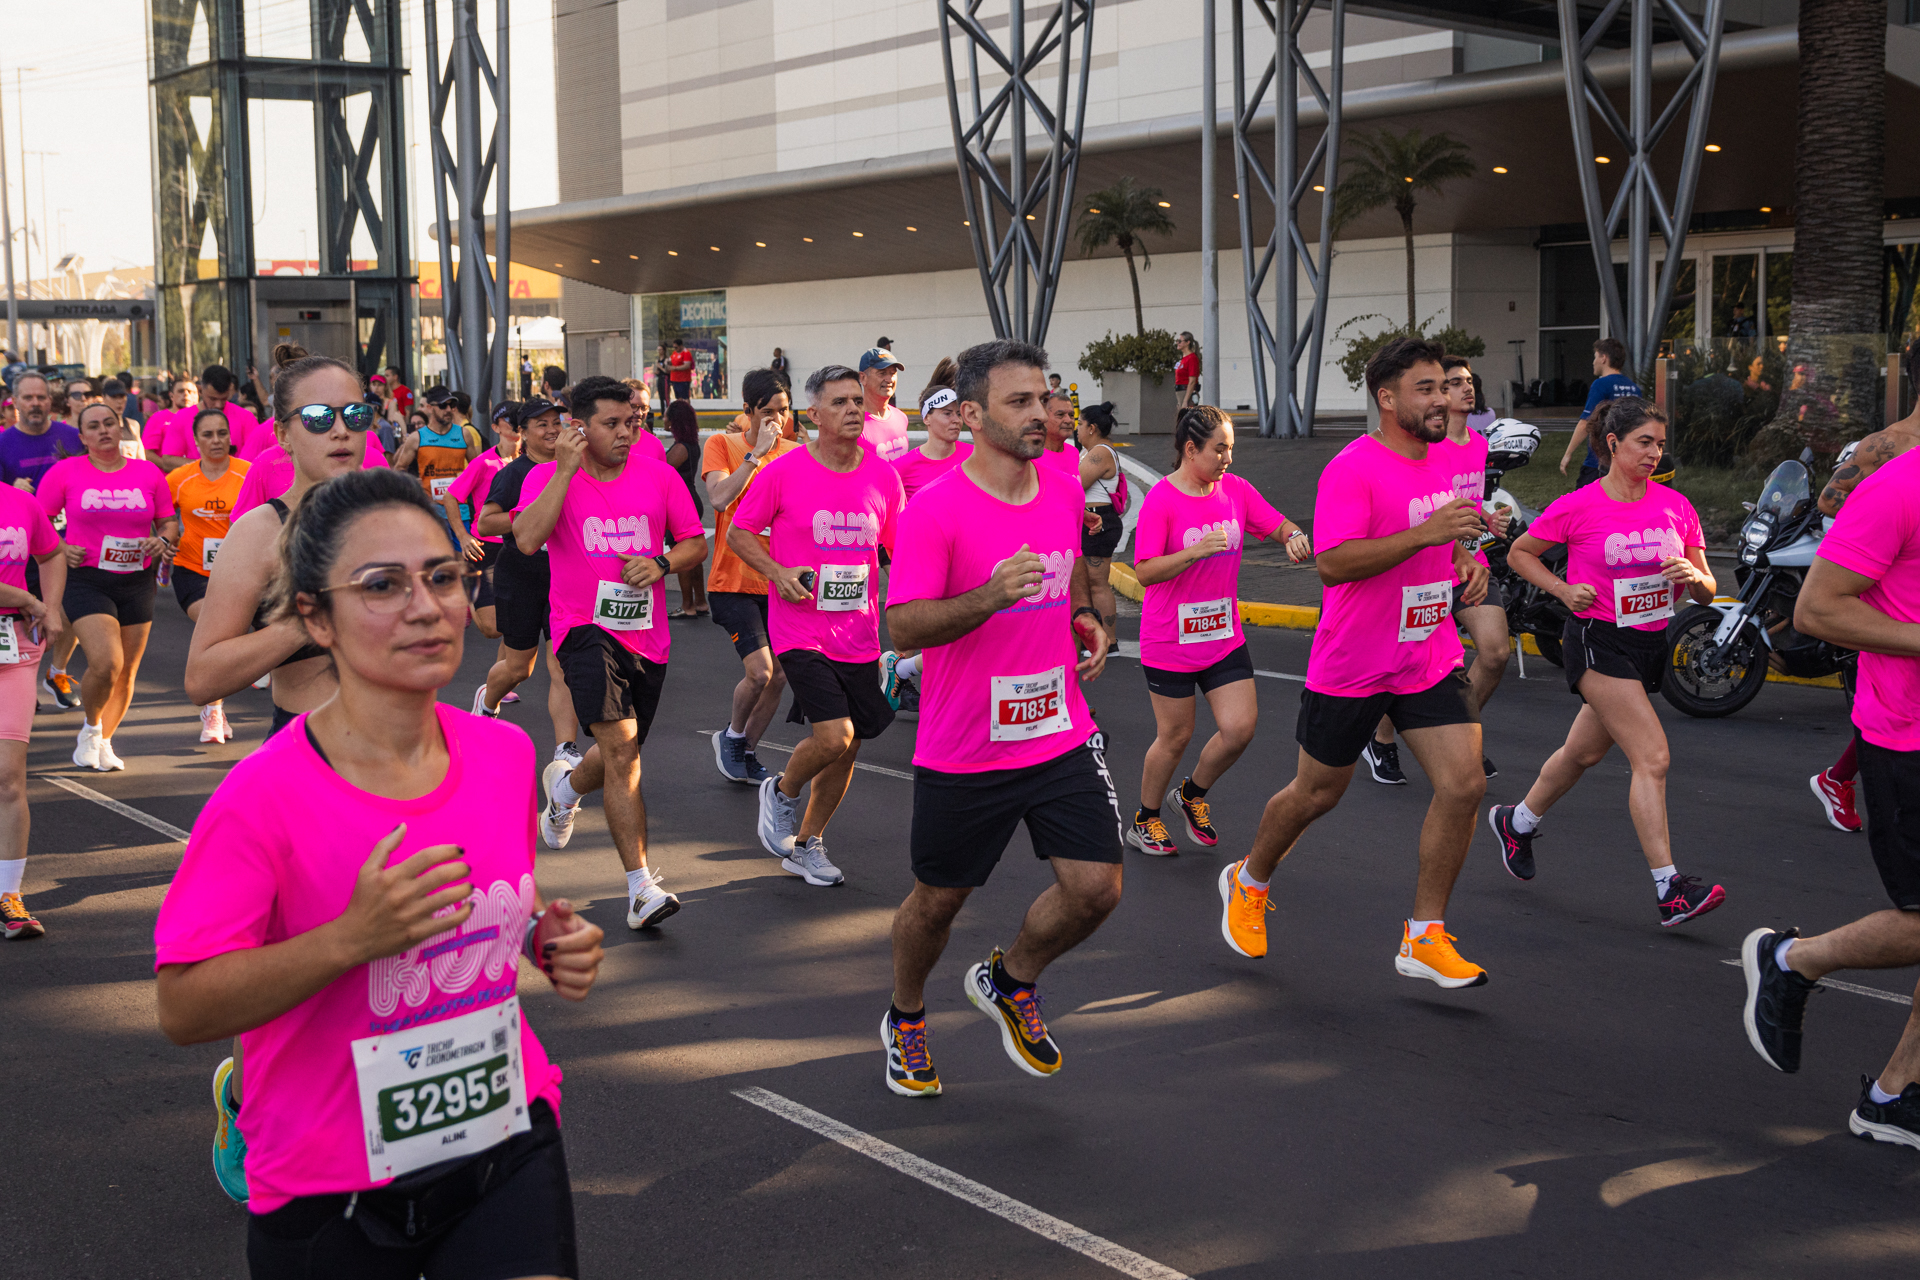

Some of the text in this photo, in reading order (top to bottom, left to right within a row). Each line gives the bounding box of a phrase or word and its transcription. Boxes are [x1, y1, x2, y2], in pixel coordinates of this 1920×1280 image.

[54, 305, 117, 314] ENTRADA
[928, 394, 948, 409] RUN
[81, 488, 147, 509] RUN
[205, 497, 226, 509] mb
[583, 515, 652, 552] RUN
[812, 510, 880, 546] RUN
[1604, 528, 1684, 566] RUN
[109, 550, 135, 562] 7207
[828, 583, 858, 598] 3209
[607, 602, 639, 617] 3177
[1627, 593, 1658, 612] 7291
[1189, 616, 1217, 632] 7184
[1412, 605, 1438, 626] 7165
[1008, 697, 1058, 722] 7183 7K
[426, 1040, 486, 1067] CRONOMETRAGEM
[427, 1038, 454, 1054] TRICHIP
[391, 1067, 489, 1132] 3295
[496, 1072, 509, 1088] 3K
[442, 1129, 468, 1145] ALINE
